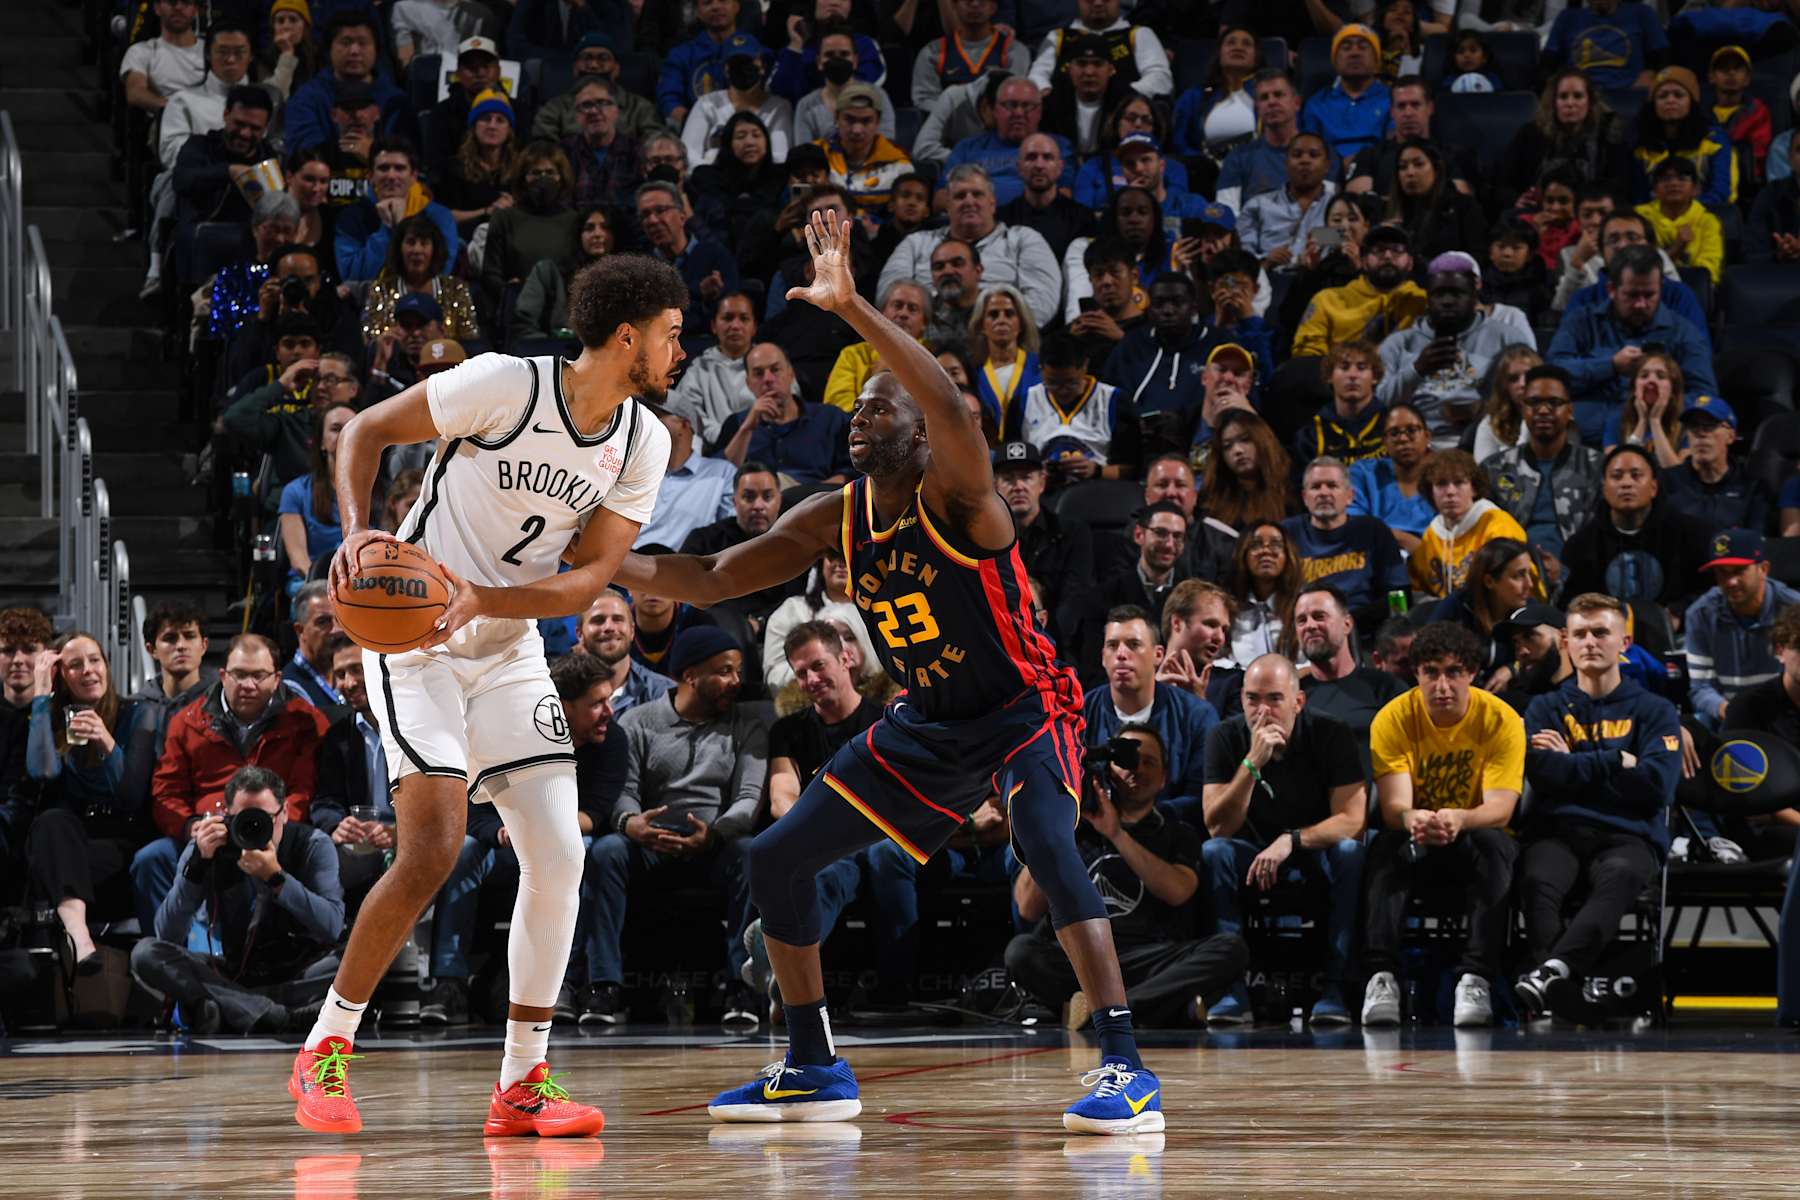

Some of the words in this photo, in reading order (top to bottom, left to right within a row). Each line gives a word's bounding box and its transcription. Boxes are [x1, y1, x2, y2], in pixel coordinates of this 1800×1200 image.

[330, 178, 354, 198] CUP
[602, 453, 624, 466] YOUR
[604, 444, 619, 455] GET
[497, 460, 604, 514] BROOKLY
[500, 515, 546, 567] 2
[352, 575, 429, 600] Wilson
[871, 591, 941, 649] 23
[919, 971, 1007, 990] CHSE
